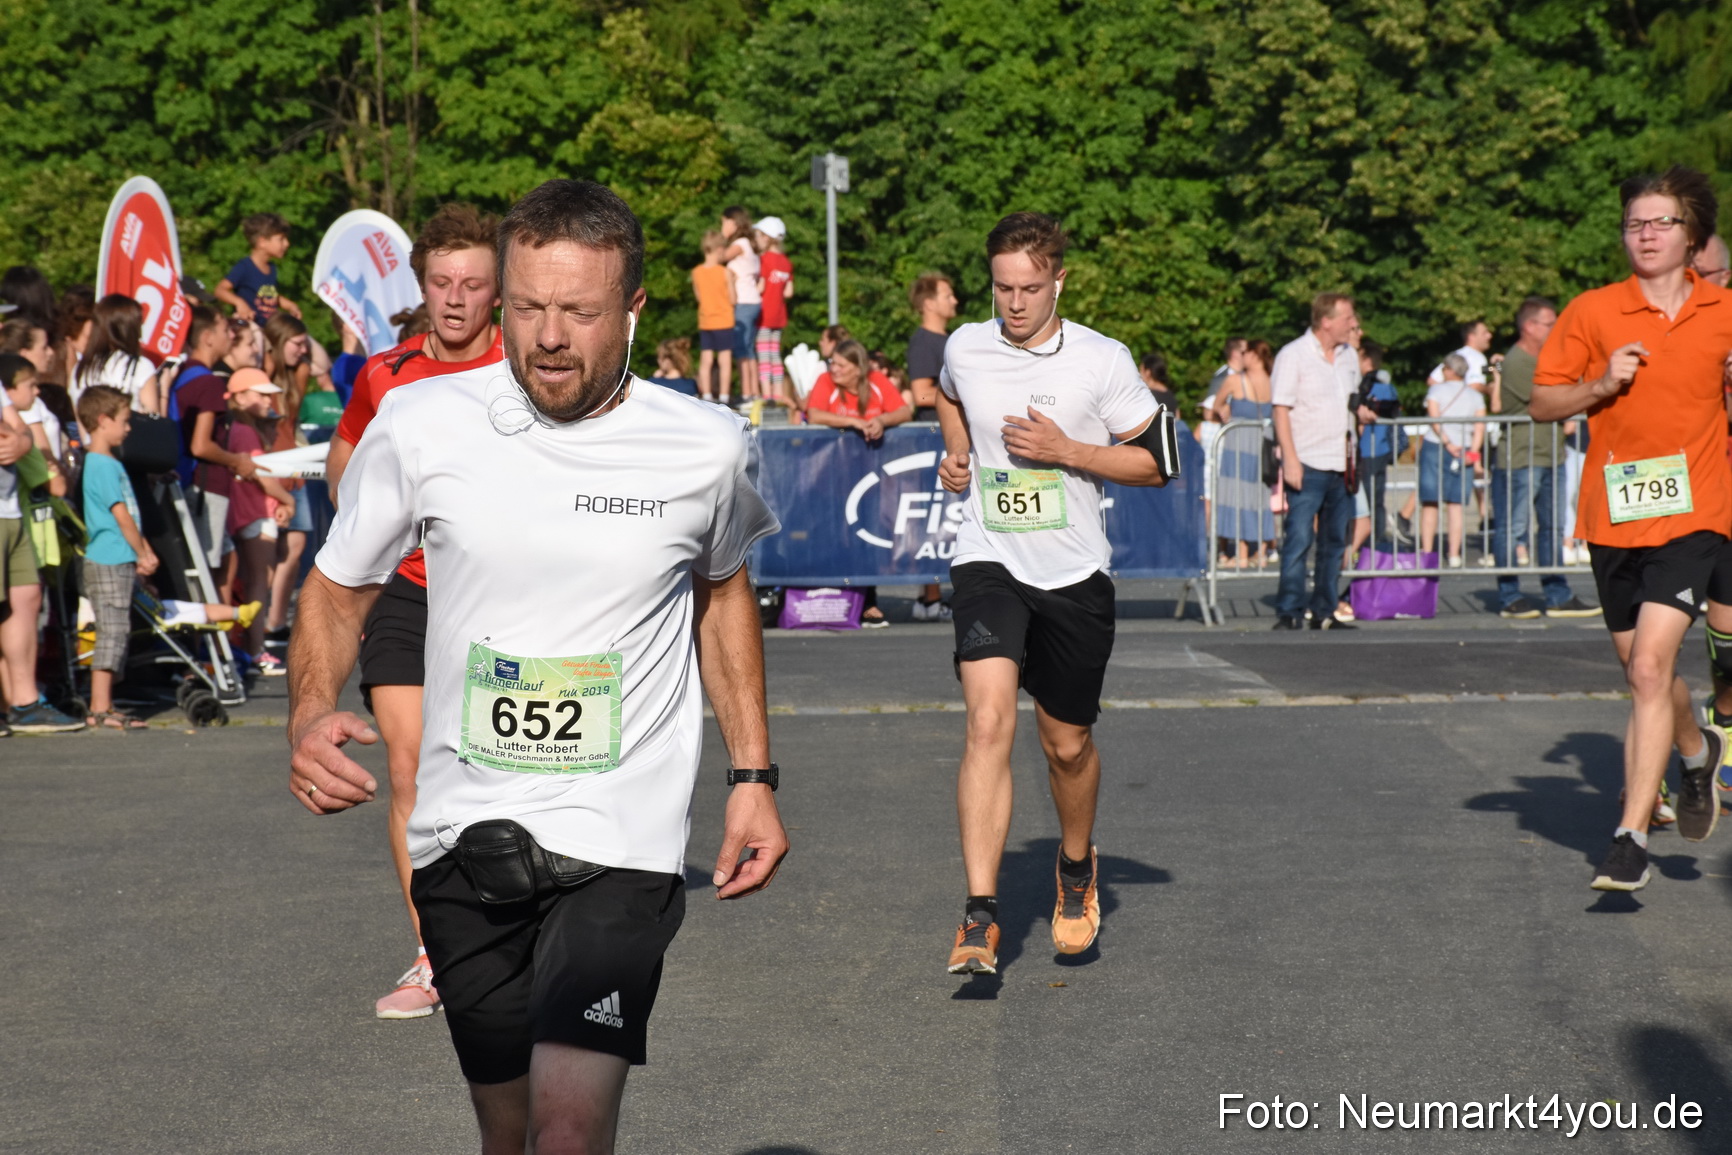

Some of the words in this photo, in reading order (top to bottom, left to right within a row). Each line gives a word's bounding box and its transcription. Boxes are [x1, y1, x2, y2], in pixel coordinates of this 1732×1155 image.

[120, 212, 138, 257] AVIA
[1030, 394, 1056, 406] NICO
[1619, 477, 1679, 504] 1798
[575, 494, 668, 518] ROBERT
[997, 491, 1042, 514] 651
[961, 636, 999, 655] adidas
[484, 671, 545, 692] firmenlauf
[582, 685, 610, 697] 2019
[492, 696, 582, 741] 652
[468, 742, 479, 751] DIE
[480, 746, 506, 758] MALER
[507, 753, 553, 762] Puschmann
[563, 755, 586, 764] Meyer
[588, 752, 610, 761] GdbR
[496, 739, 532, 753] Lutter
[536, 743, 579, 754] Robert
[583, 1008, 624, 1029] adidas
